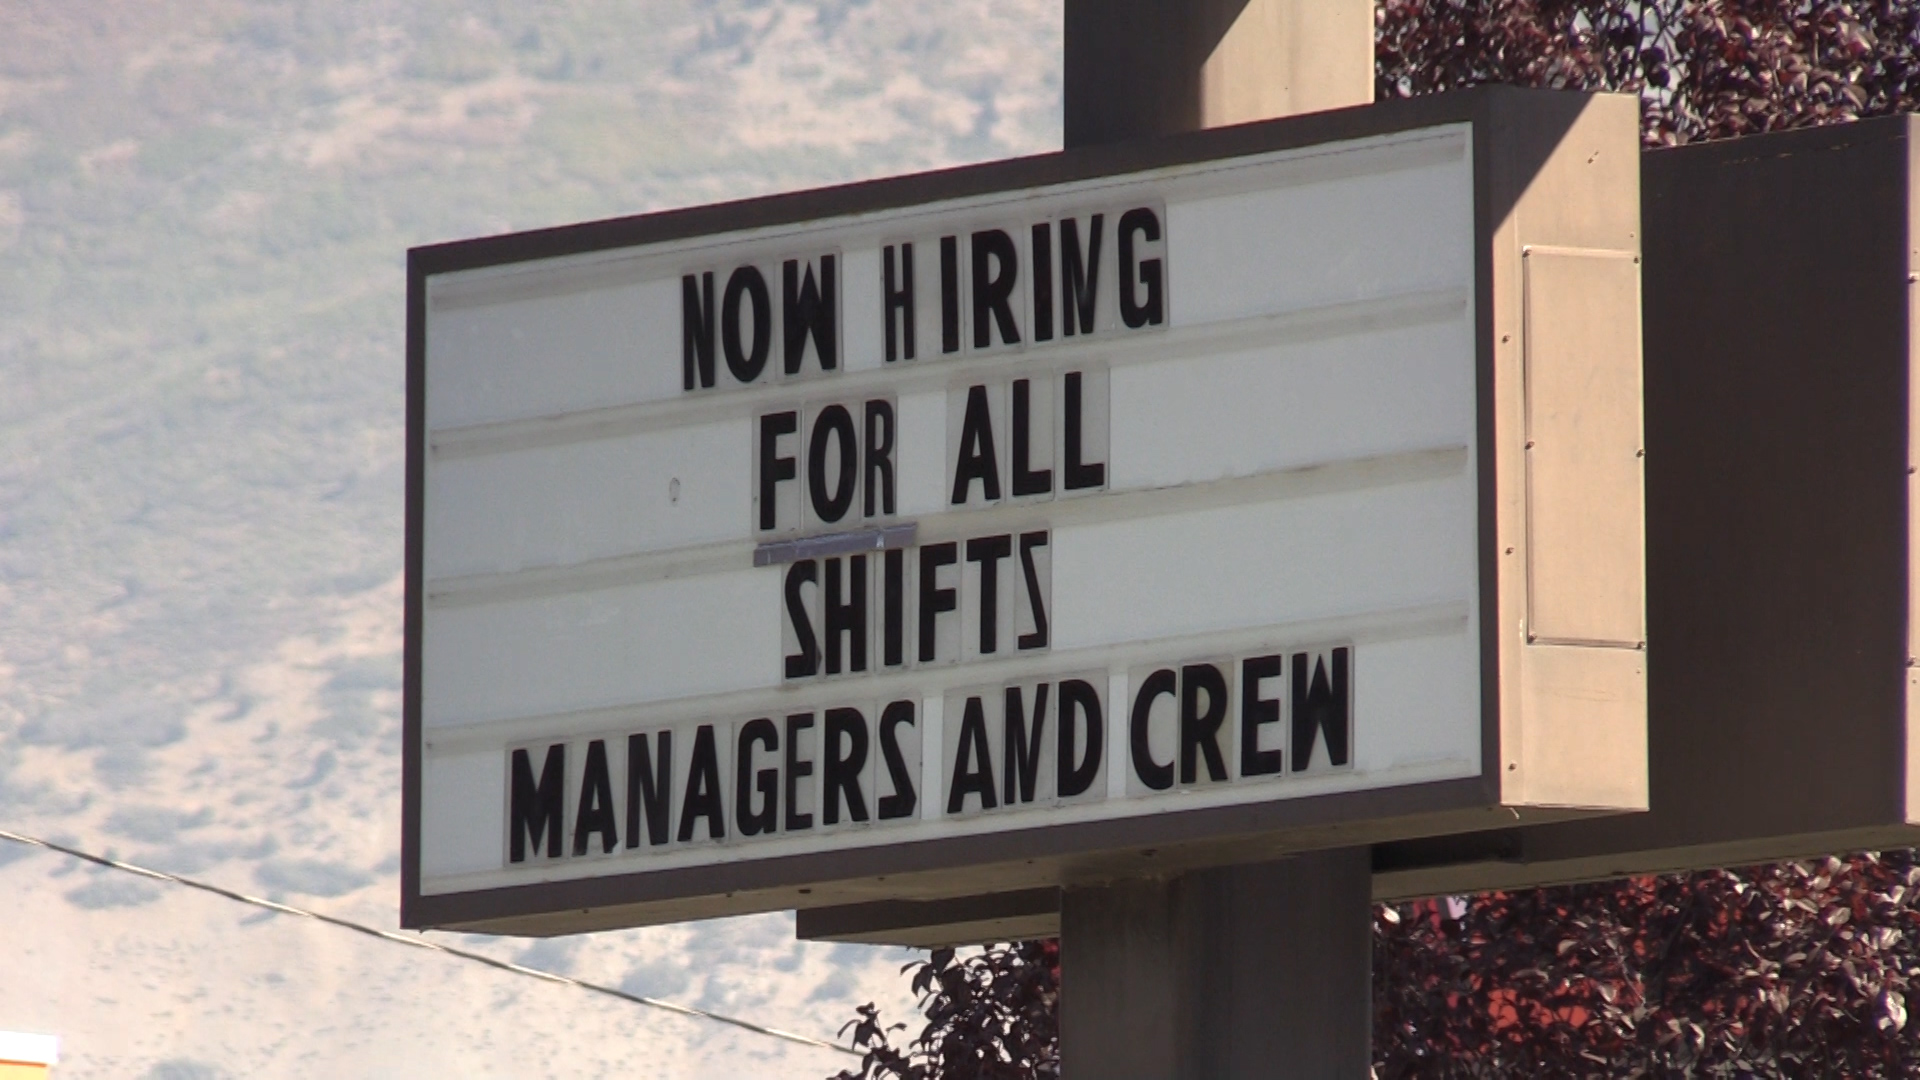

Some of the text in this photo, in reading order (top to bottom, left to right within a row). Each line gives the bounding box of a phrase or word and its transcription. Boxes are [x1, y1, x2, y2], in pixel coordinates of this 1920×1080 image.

[681, 206, 1164, 393] NOW HIRING
[759, 370, 1105, 532] FOR ALL
[784, 529, 1049, 680] SHIFTS
[509, 646, 1349, 865] MANAGERS AND CREW
